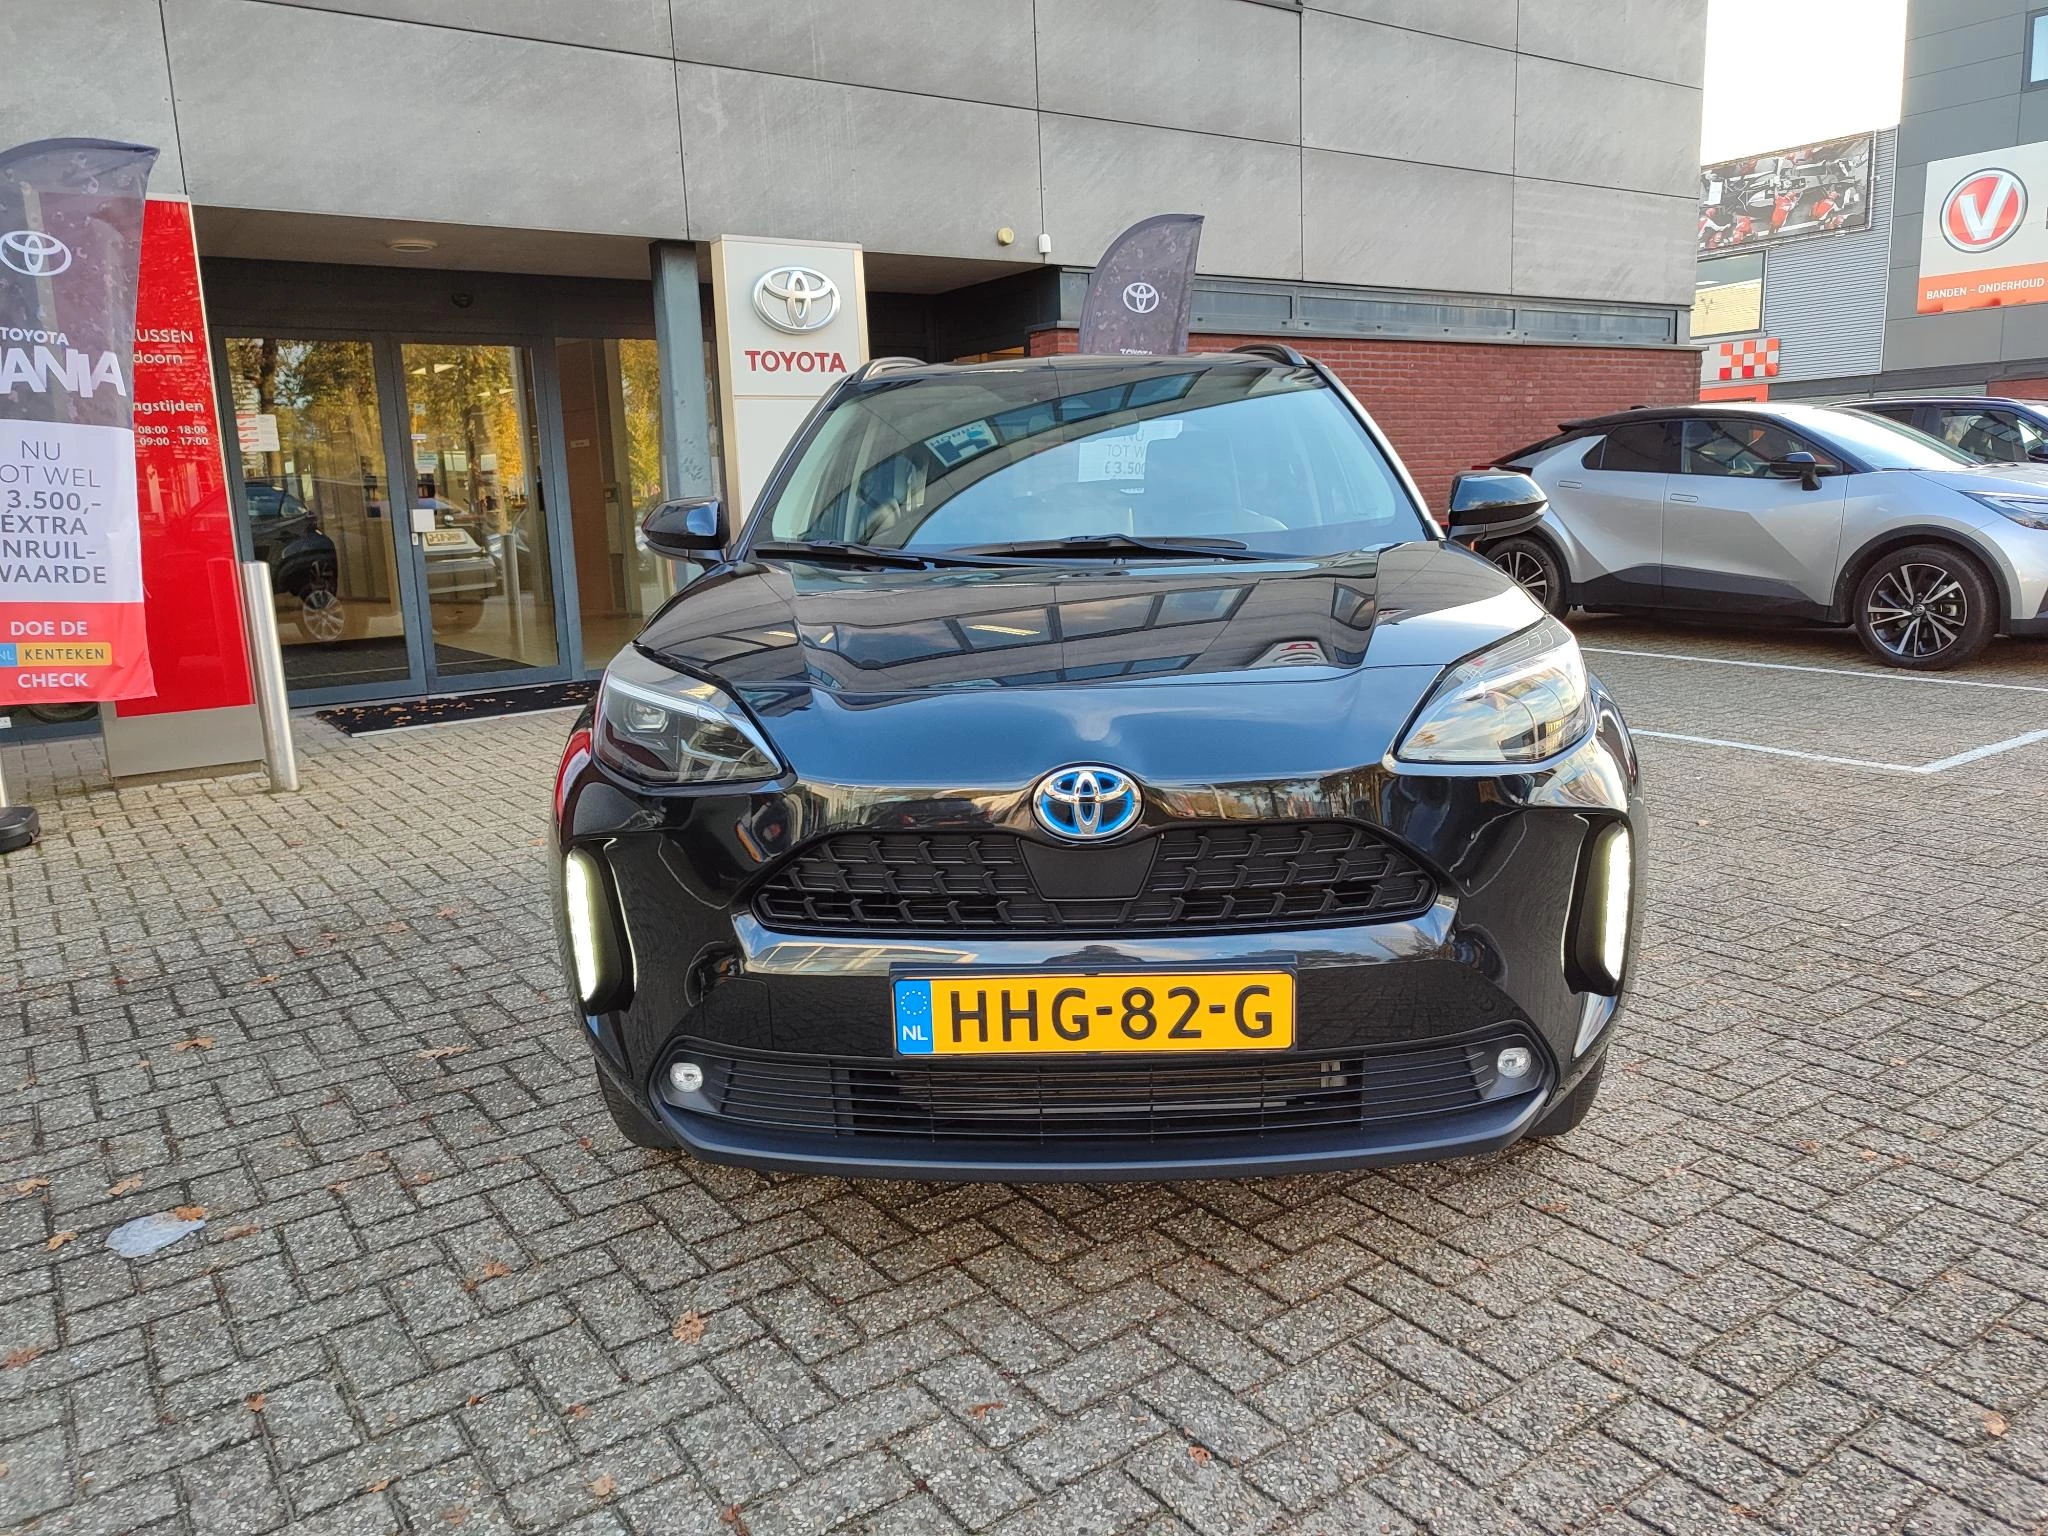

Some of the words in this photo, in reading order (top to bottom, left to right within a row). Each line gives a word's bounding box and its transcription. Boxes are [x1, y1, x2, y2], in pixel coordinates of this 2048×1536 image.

[1926, 286, 1967, 300] BANDEN
[1978, 277, 2045, 294] ONDERHOUD
[0, 327, 70, 346] TOYOTA
[134, 329, 194, 343] USSEN
[744, 350, 847, 373] TOYOTA
[0, 345, 127, 398] ANIA
[138, 425, 168, 434] 08:00
[178, 425, 207, 434] 18:00
[21, 440, 60, 461] NU
[140, 437, 169, 446] 09:00
[180, 437, 208, 446] 17:00
[1106, 444, 1130, 457] TOT
[43, 466, 102, 488] WEL
[3, 539, 97, 560] NRUIL-
[10, 621, 56, 636] DOE
[60, 621, 88, 636] DE
[25, 648, 104, 660] KENTEKEN
[17, 672, 88, 688] CHECK
[901, 1024, 929, 1041] NL
[949, 985, 1274, 1043] HHG-82-G
